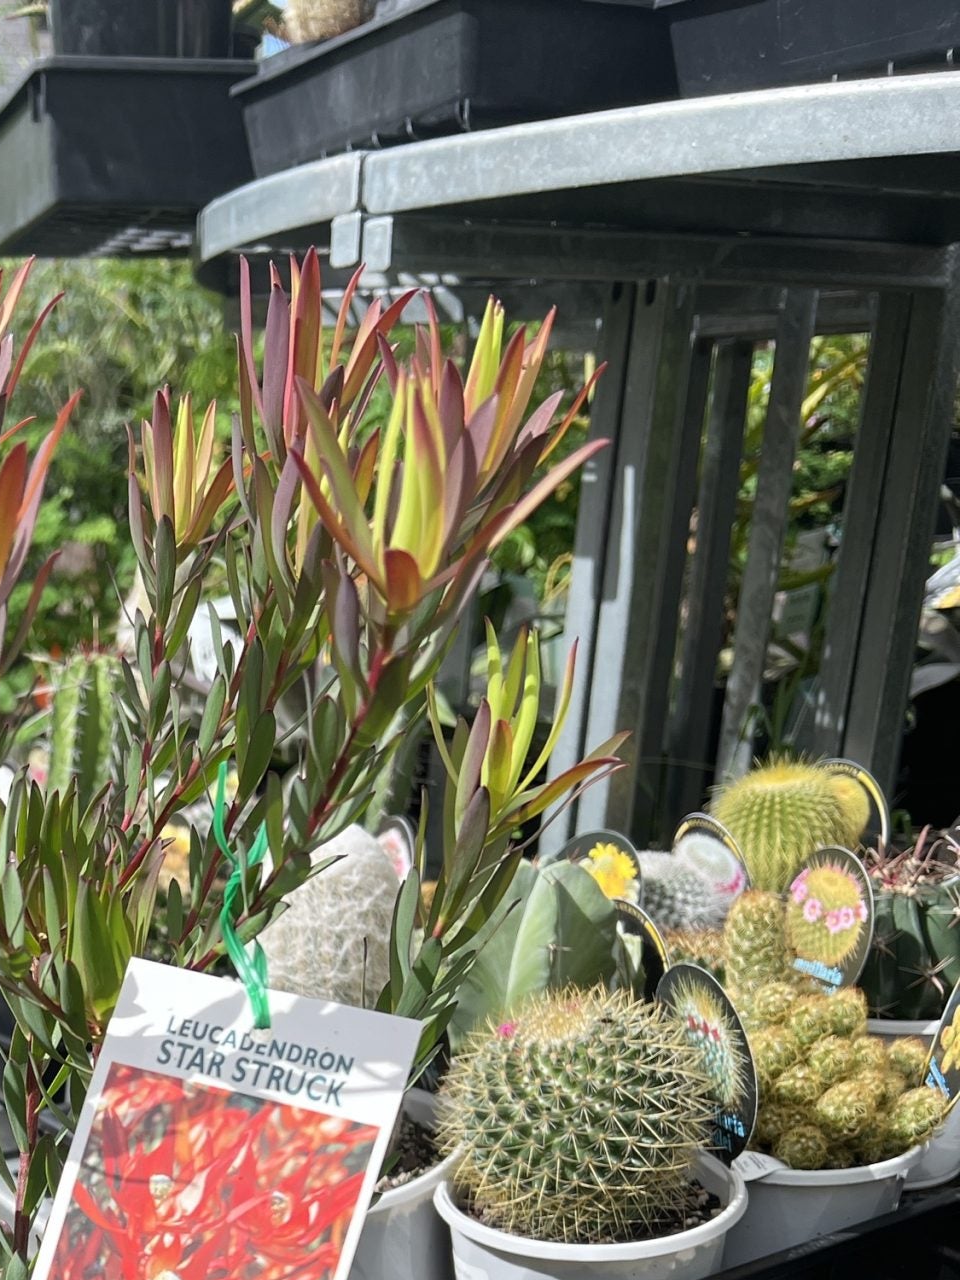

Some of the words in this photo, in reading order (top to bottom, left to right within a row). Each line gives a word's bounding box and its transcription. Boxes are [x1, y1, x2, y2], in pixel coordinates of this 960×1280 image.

[157, 1039, 226, 1078] STAR
[231, 1057, 346, 1107] STRUCK
[166, 1015, 354, 1075] LEUCADENDRON
